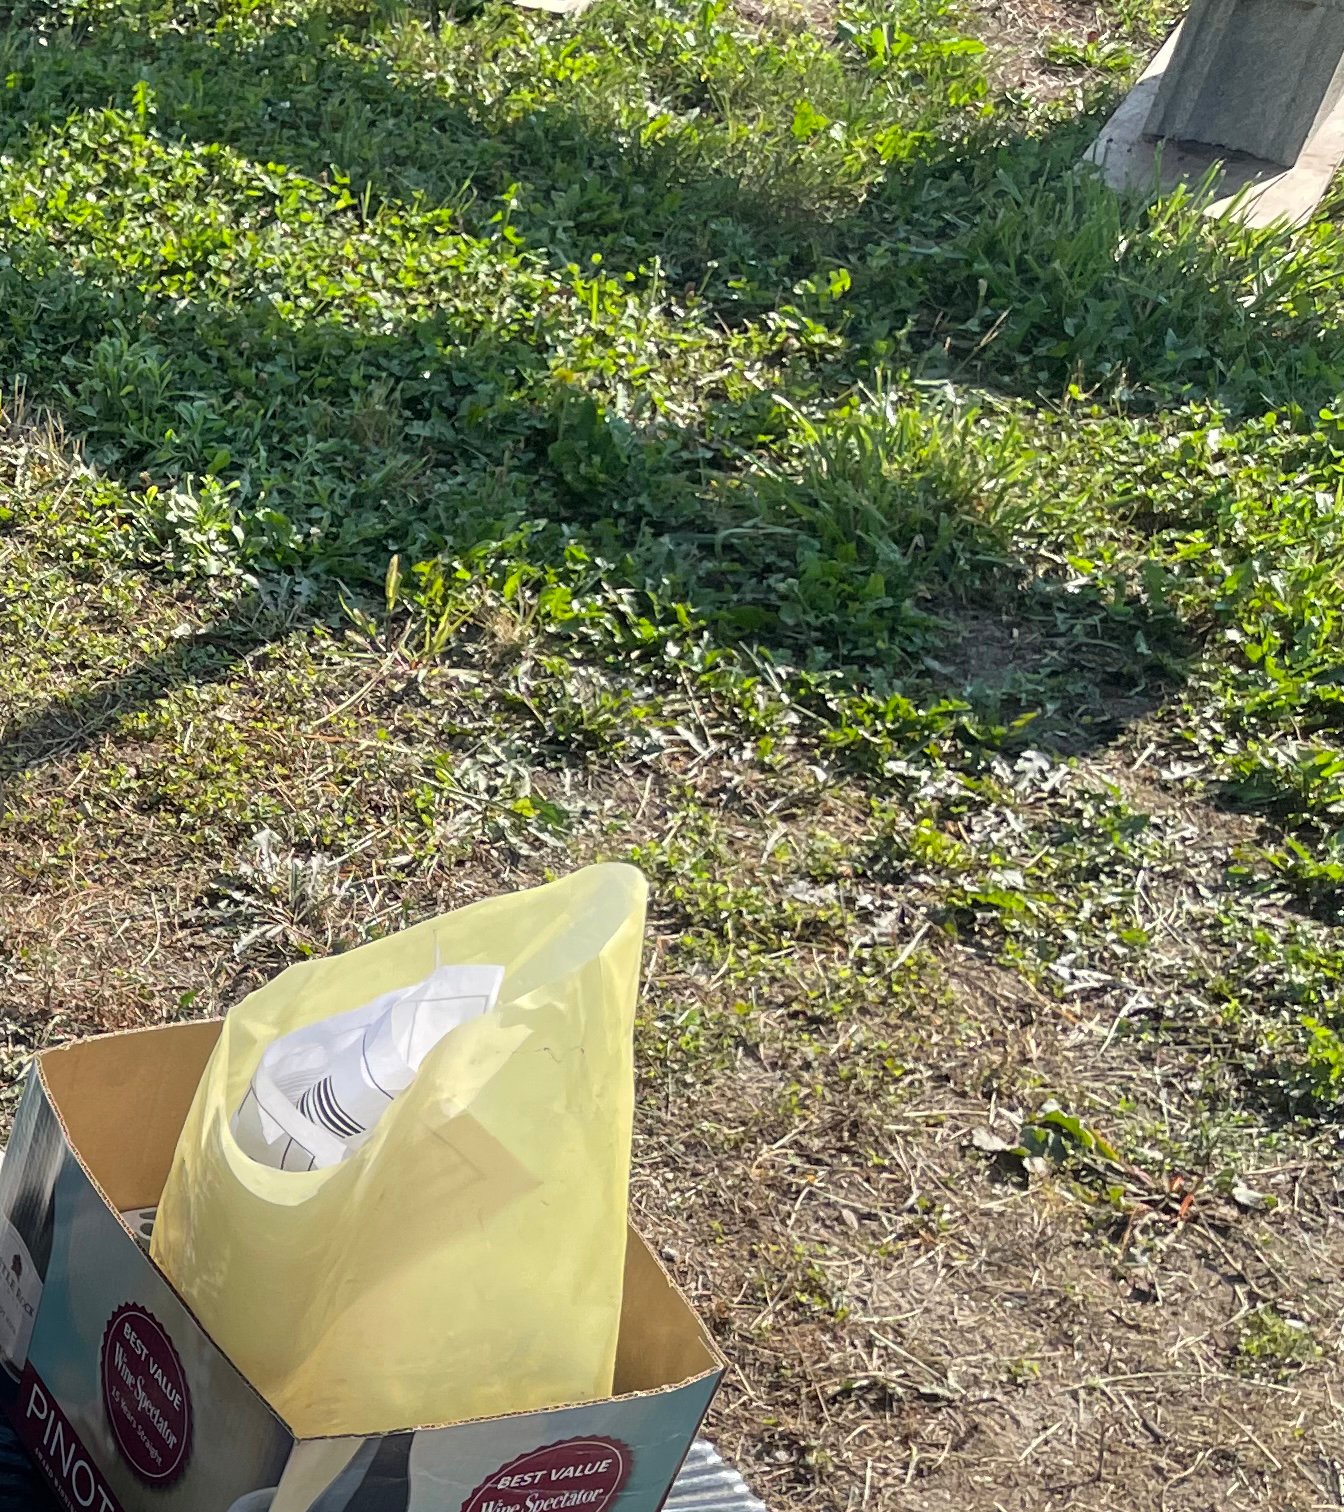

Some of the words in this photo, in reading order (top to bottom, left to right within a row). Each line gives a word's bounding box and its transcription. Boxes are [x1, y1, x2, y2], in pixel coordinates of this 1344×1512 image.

[114, 1341, 136, 1391] Wine
[134, 1375, 178, 1451] Spectator
[123, 1321, 150, 1363] BEST
[149, 1356, 182, 1412] VALUE
[111, 1385, 121, 1403] 15
[120, 1401, 137, 1429] Years
[137, 1423, 163, 1467] Straight
[497, 1470, 547, 1490] BEST
[550, 1459, 612, 1481] VALUE
